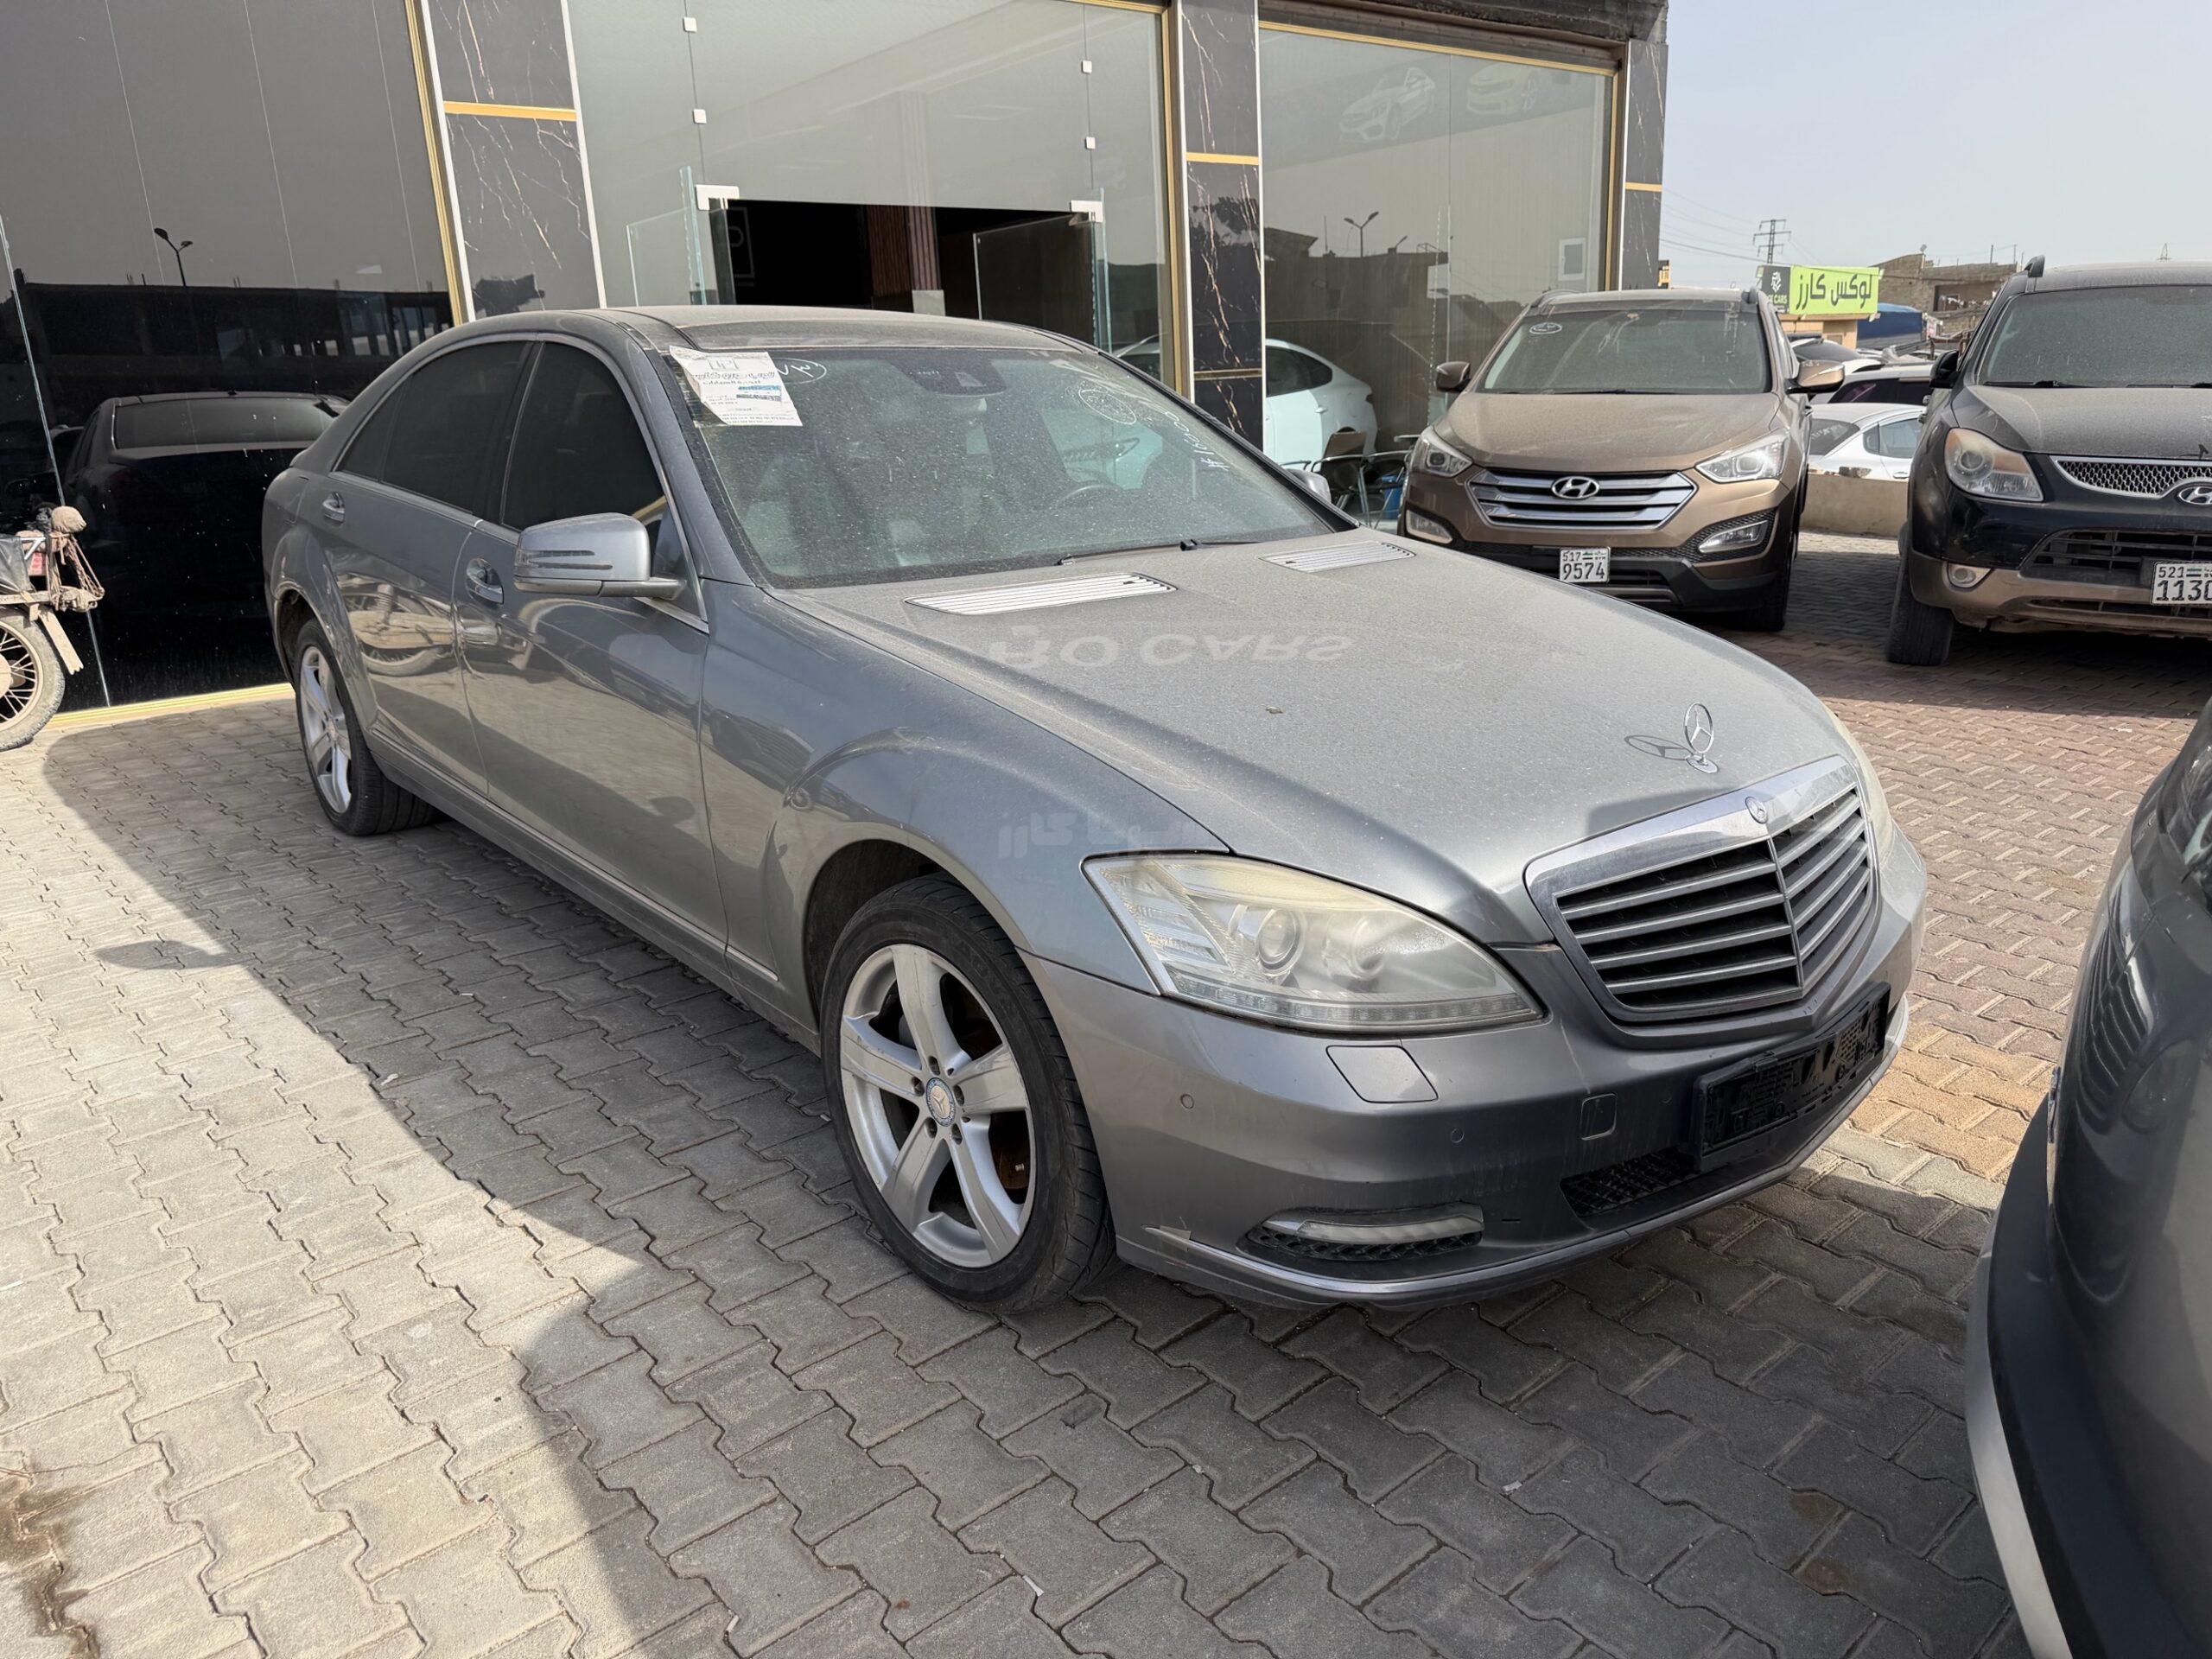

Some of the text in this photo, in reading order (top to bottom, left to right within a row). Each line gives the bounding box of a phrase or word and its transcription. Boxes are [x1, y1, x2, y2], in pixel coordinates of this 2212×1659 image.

[1796, 272, 1872, 310] لوكس كارز
[1562, 551, 1581, 562] 517
[1562, 562, 1605, 581] 9574
[2158, 566, 2184, 578] 521
